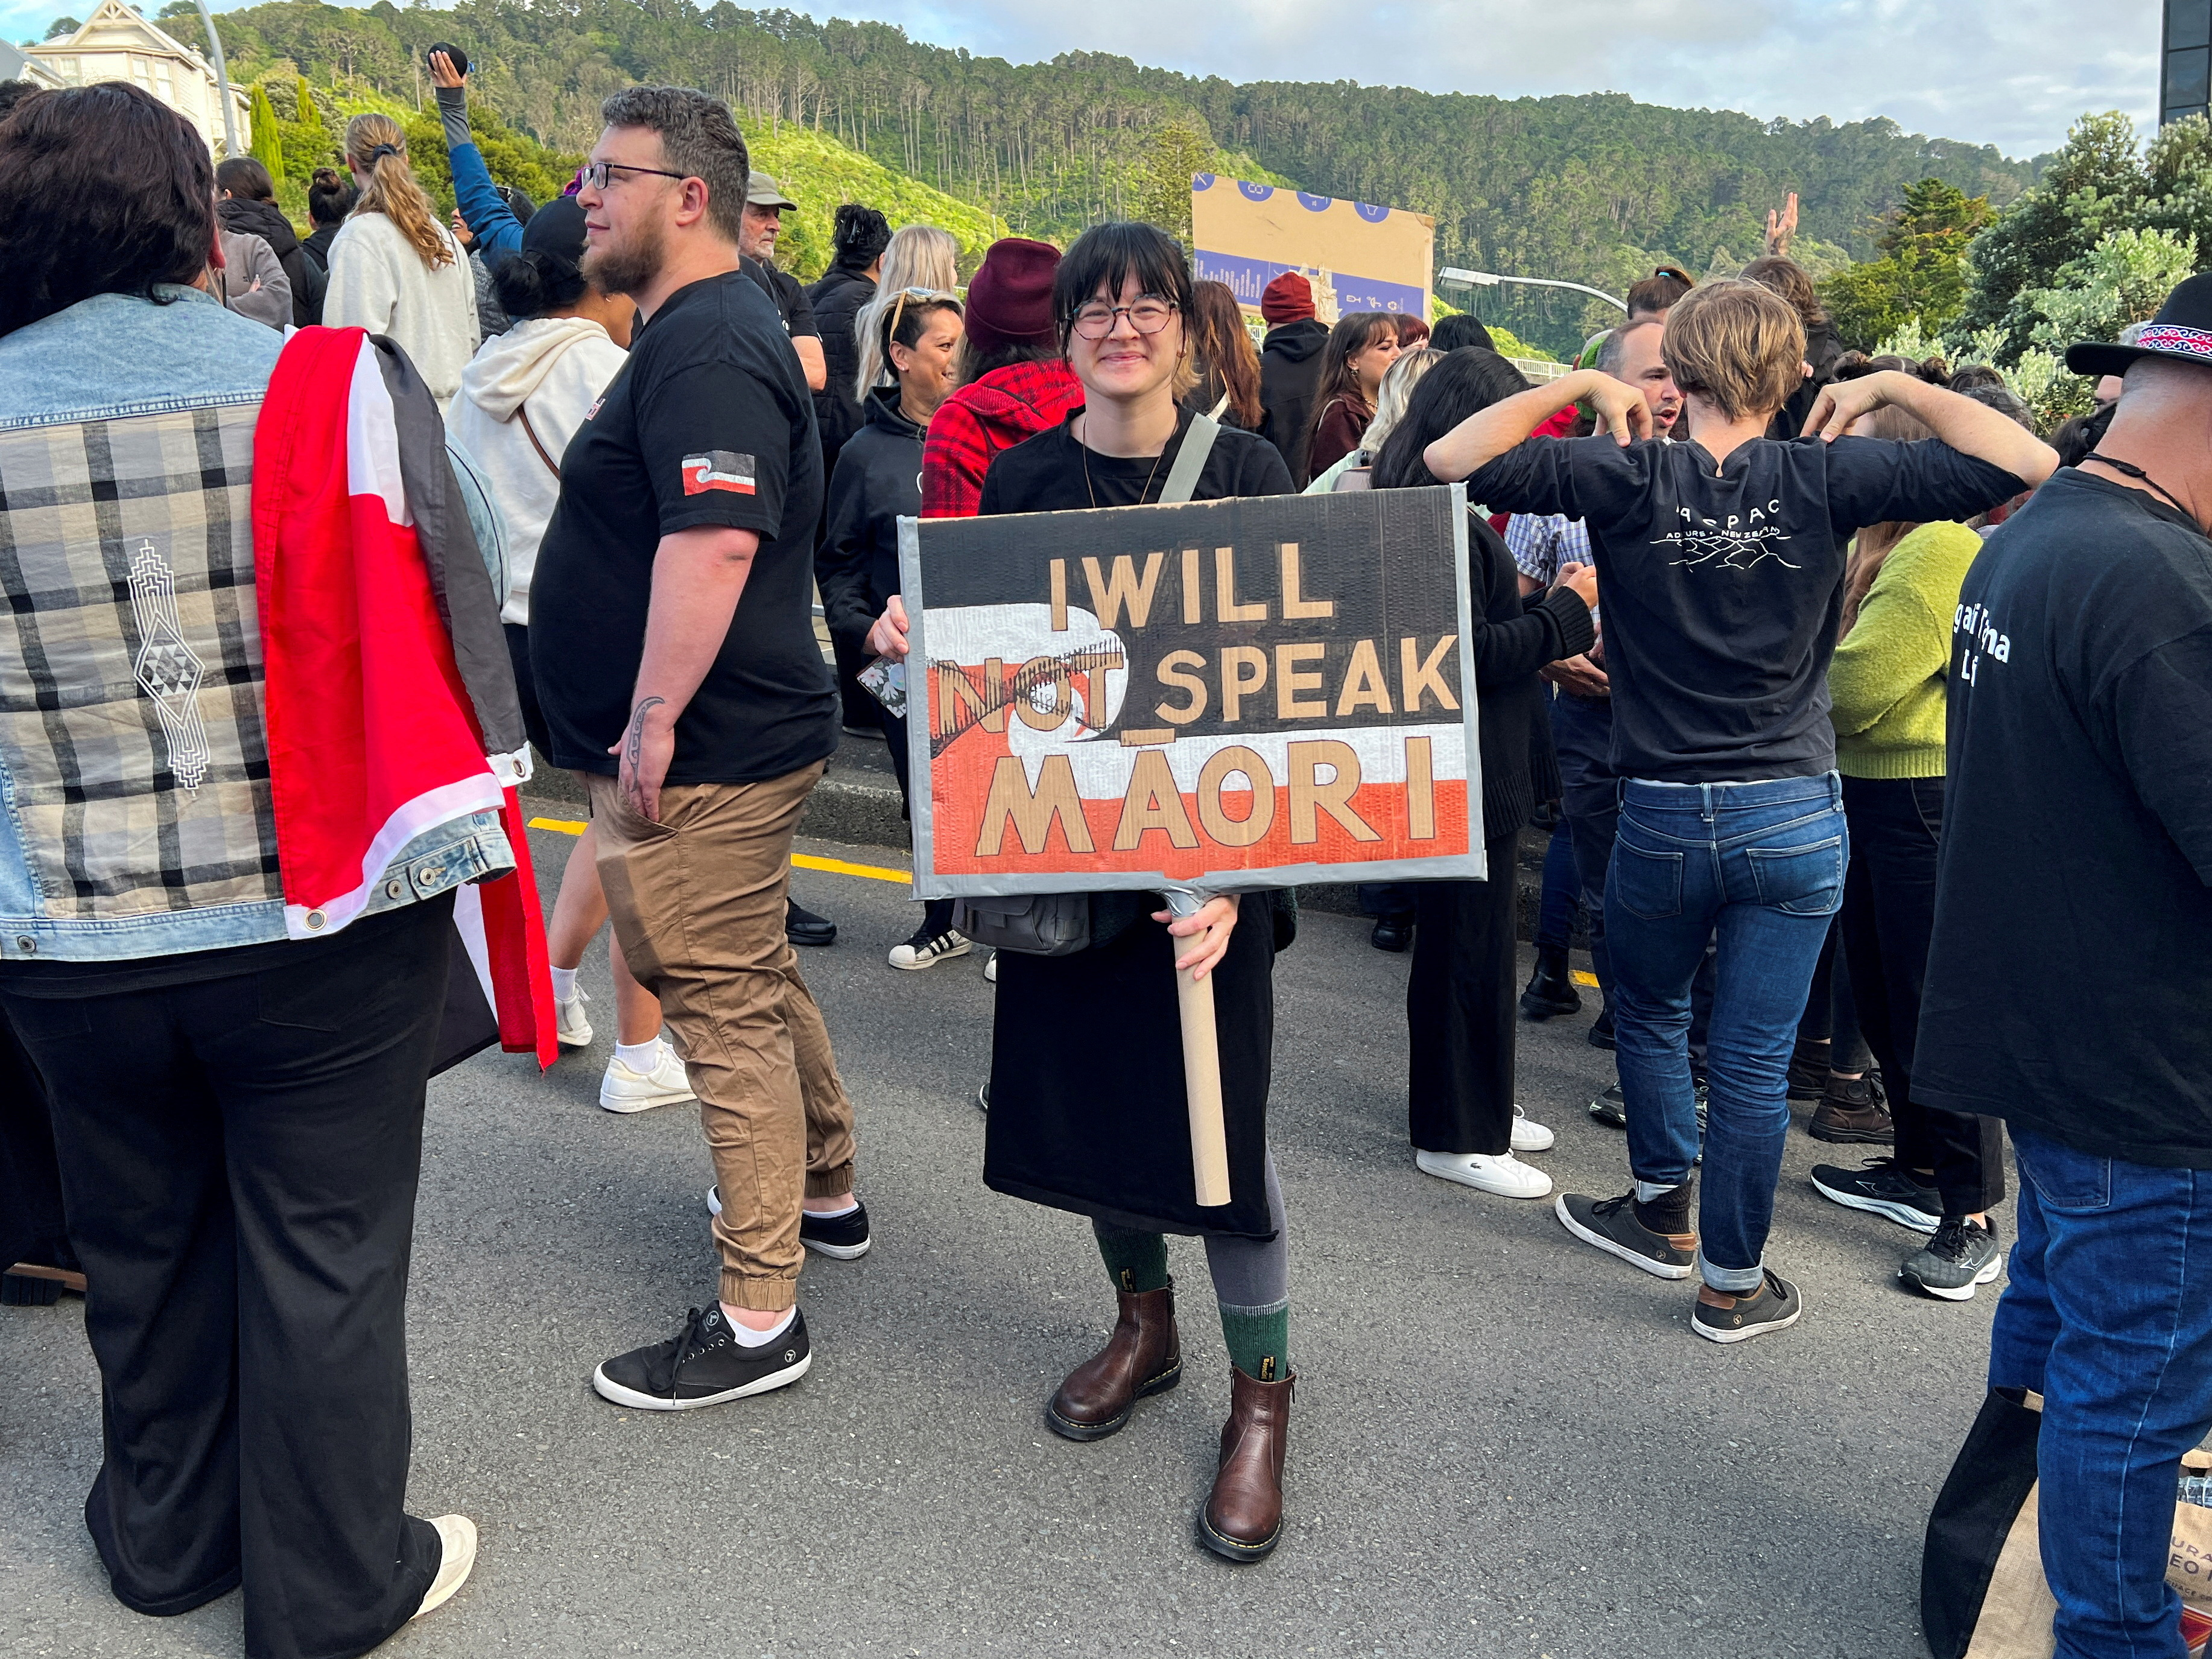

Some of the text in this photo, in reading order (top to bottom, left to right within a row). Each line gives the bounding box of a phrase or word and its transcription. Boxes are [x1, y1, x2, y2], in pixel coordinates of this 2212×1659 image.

[1722, 530, 1741, 539] NEW
[1050, 542, 1334, 632] I WILL
[937, 634, 1462, 734] NOT SPEAK
[974, 728, 1435, 857] MĀORI
